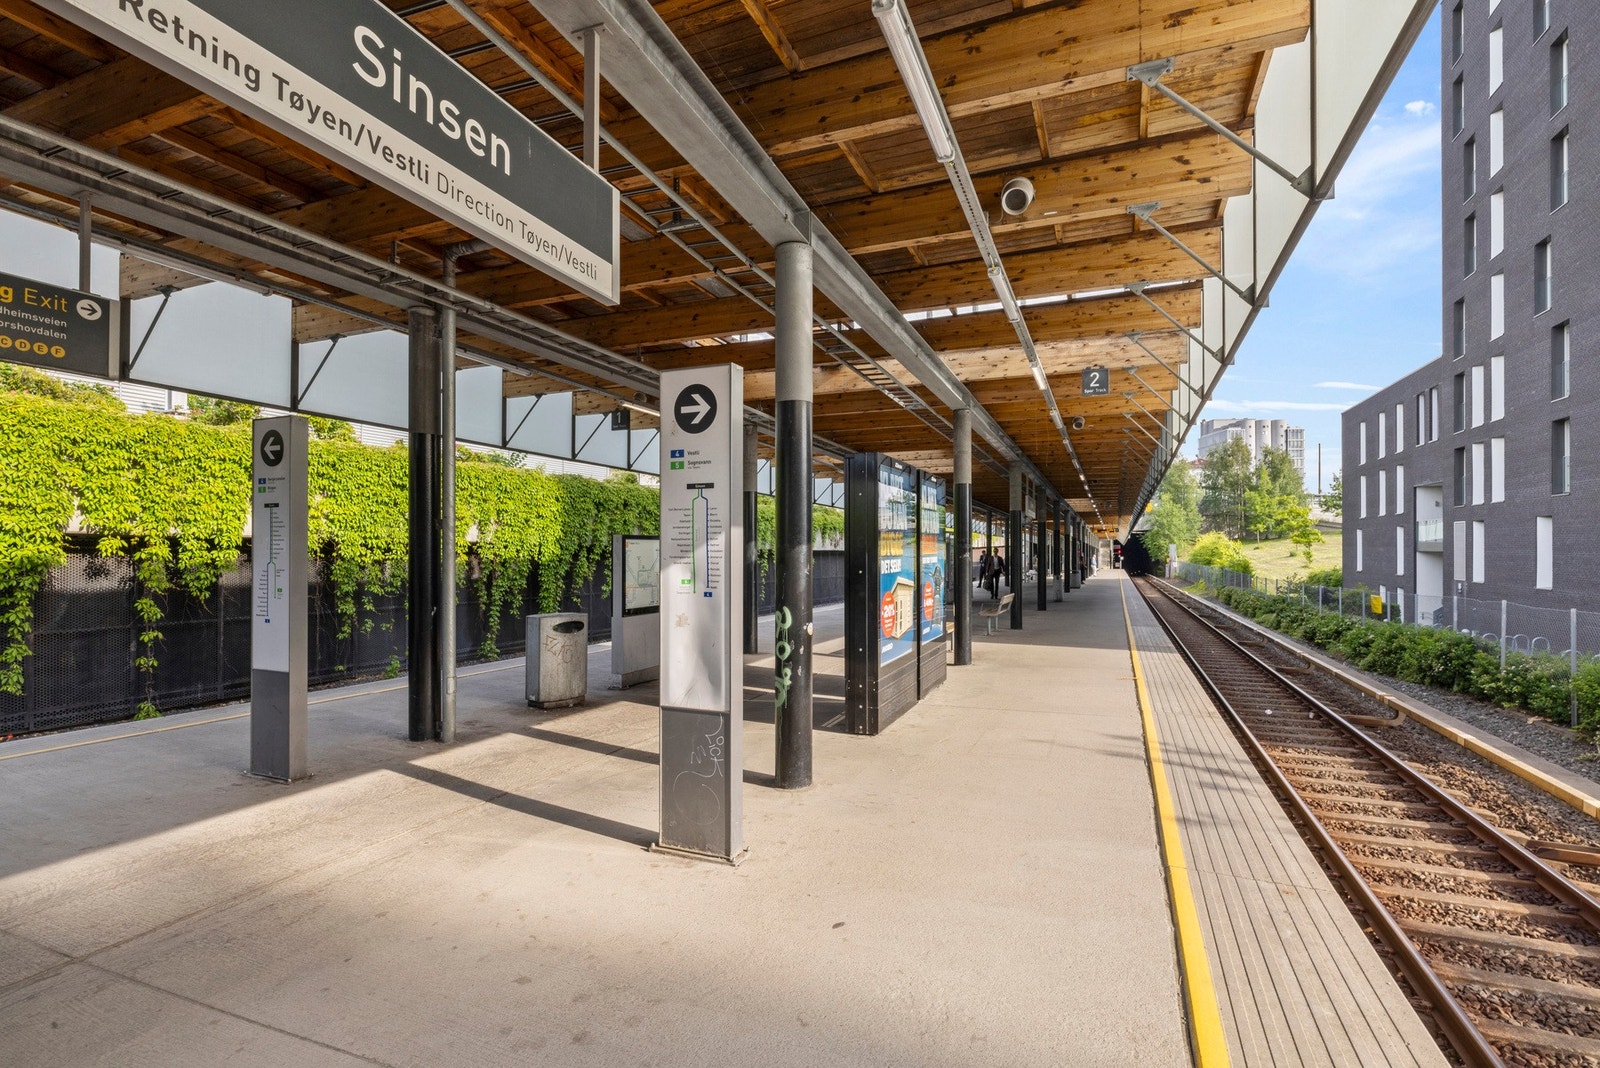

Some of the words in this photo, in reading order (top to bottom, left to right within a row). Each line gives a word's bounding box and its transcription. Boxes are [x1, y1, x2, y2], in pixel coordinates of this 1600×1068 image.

[351, 24, 512, 178] Sinsen
[118, 0, 261, 93] Retning
[264, 69, 430, 186] Tøyen/Vestli
[436, 171, 515, 234] Direction
[518, 219, 598, 282] Tøyen/Vestli
[24, 287, 68, 312] Exit
[19, 341, 27, 349] D
[38, 344, 44, 352] E
[1090, 371, 1100, 387] 2
[616, 412, 621, 424] 1
